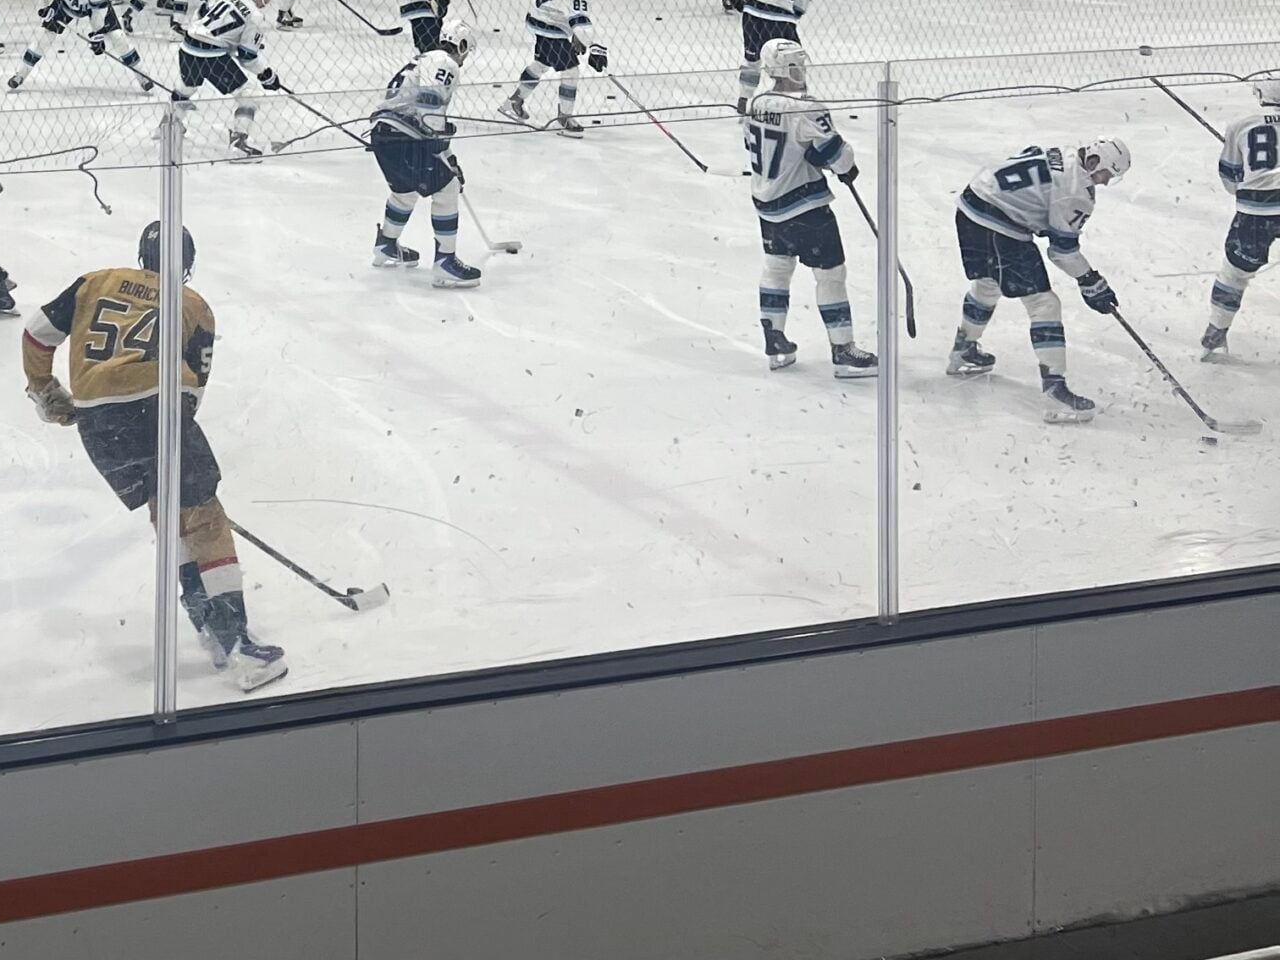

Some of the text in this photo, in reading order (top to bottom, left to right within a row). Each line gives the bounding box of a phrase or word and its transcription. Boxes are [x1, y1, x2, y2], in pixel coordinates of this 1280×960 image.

[203, 0, 245, 37] 47
[435, 68, 454, 86] 26
[749, 124, 787, 179] 37
[84, 296, 160, 363] 54
